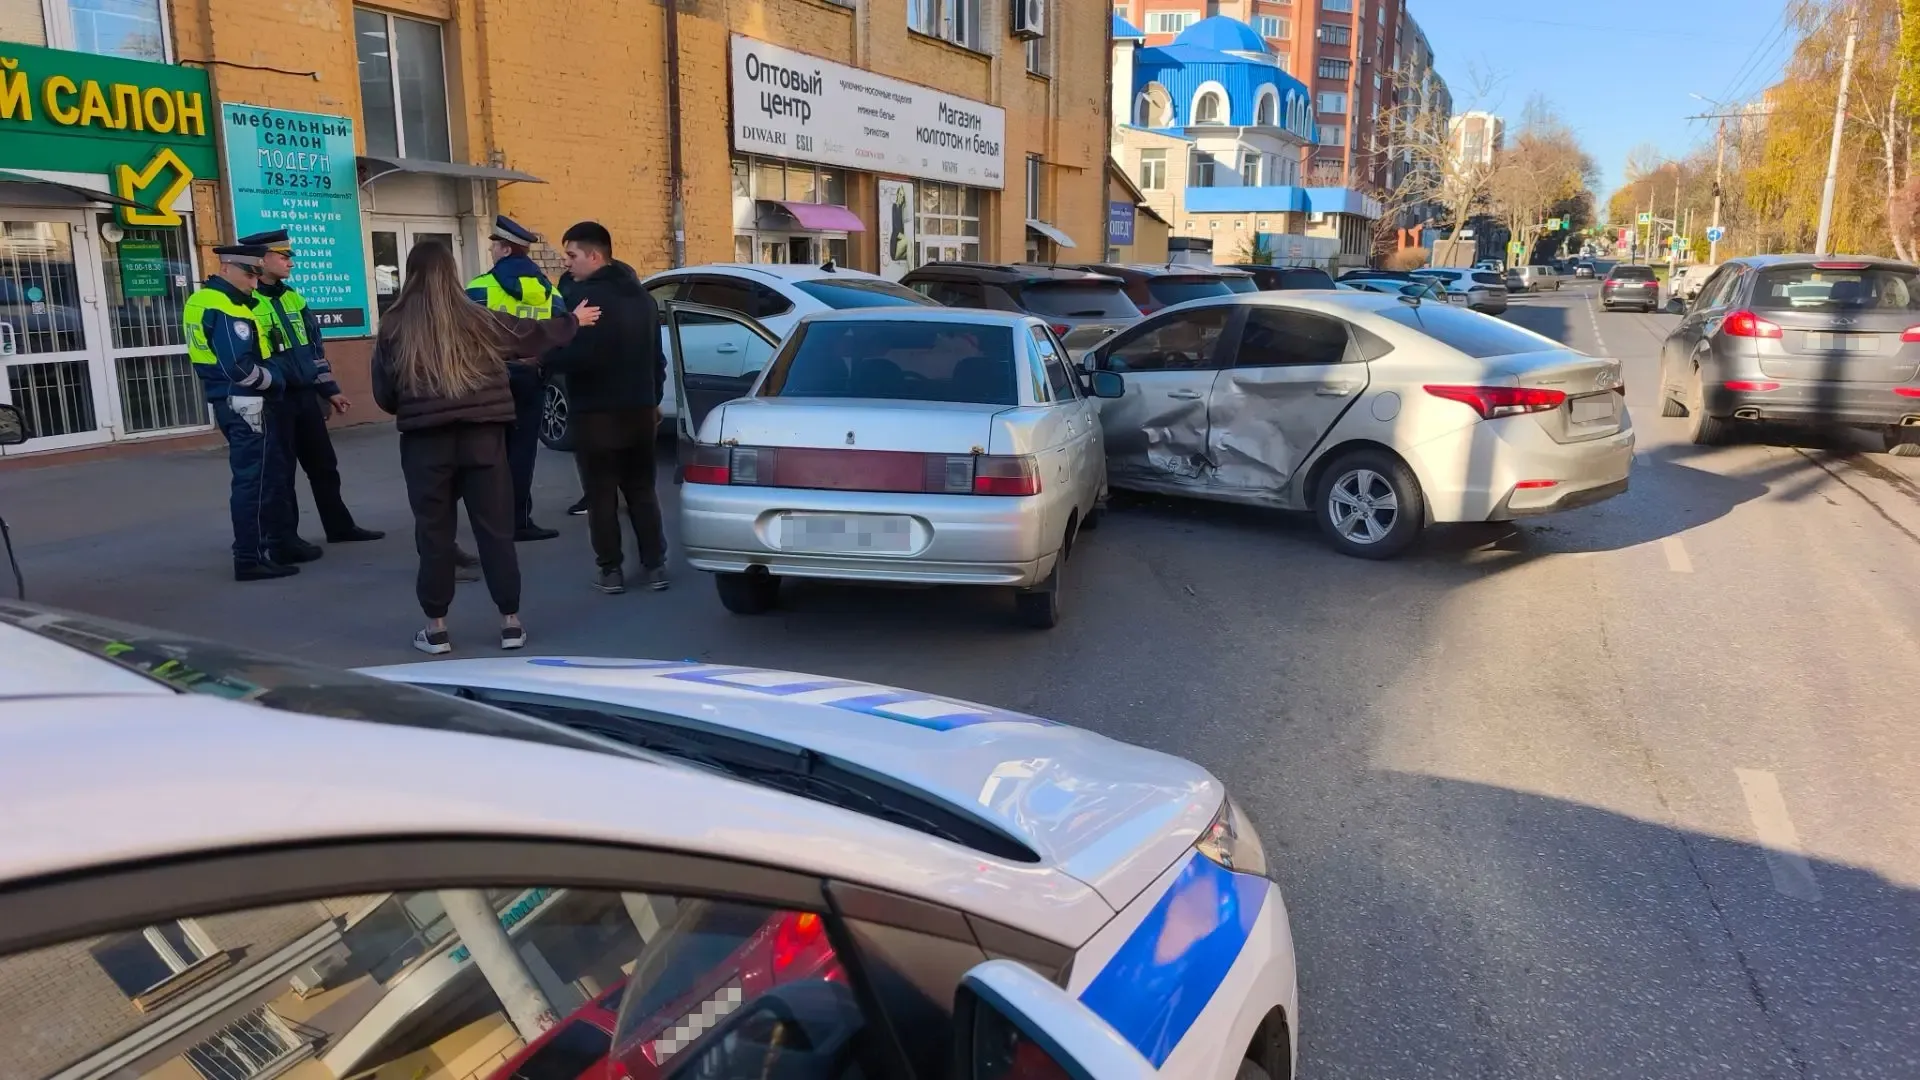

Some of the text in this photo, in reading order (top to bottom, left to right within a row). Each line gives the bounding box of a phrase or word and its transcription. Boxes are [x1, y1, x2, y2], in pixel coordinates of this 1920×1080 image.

[745, 53, 823, 97] Оптовый
[42, 75, 205, 136] САЛОН
[760, 90, 812, 125] центр
[232, 112, 347, 137] мебельный
[938, 101, 982, 131] Магазин
[264, 131, 321, 149] салон
[742, 125, 787, 145] DIWARI
[916, 125, 1000, 157] колготок и белья
[257, 148, 331, 173] МОДЕРН
[264, 171, 332, 190] 78-23-79
[282, 198, 319, 209] кухни
[260, 209, 342, 221] шкафы-купе
[281, 222, 326, 233] стенки
[288, 235, 336, 245] ихожие
[295, 248, 332, 257] альни
[293, 260, 333, 269] тские
[285, 272, 350, 283] деробные
[297, 285, 352, 295] ы-стулья
[315, 313, 343, 325] таж
